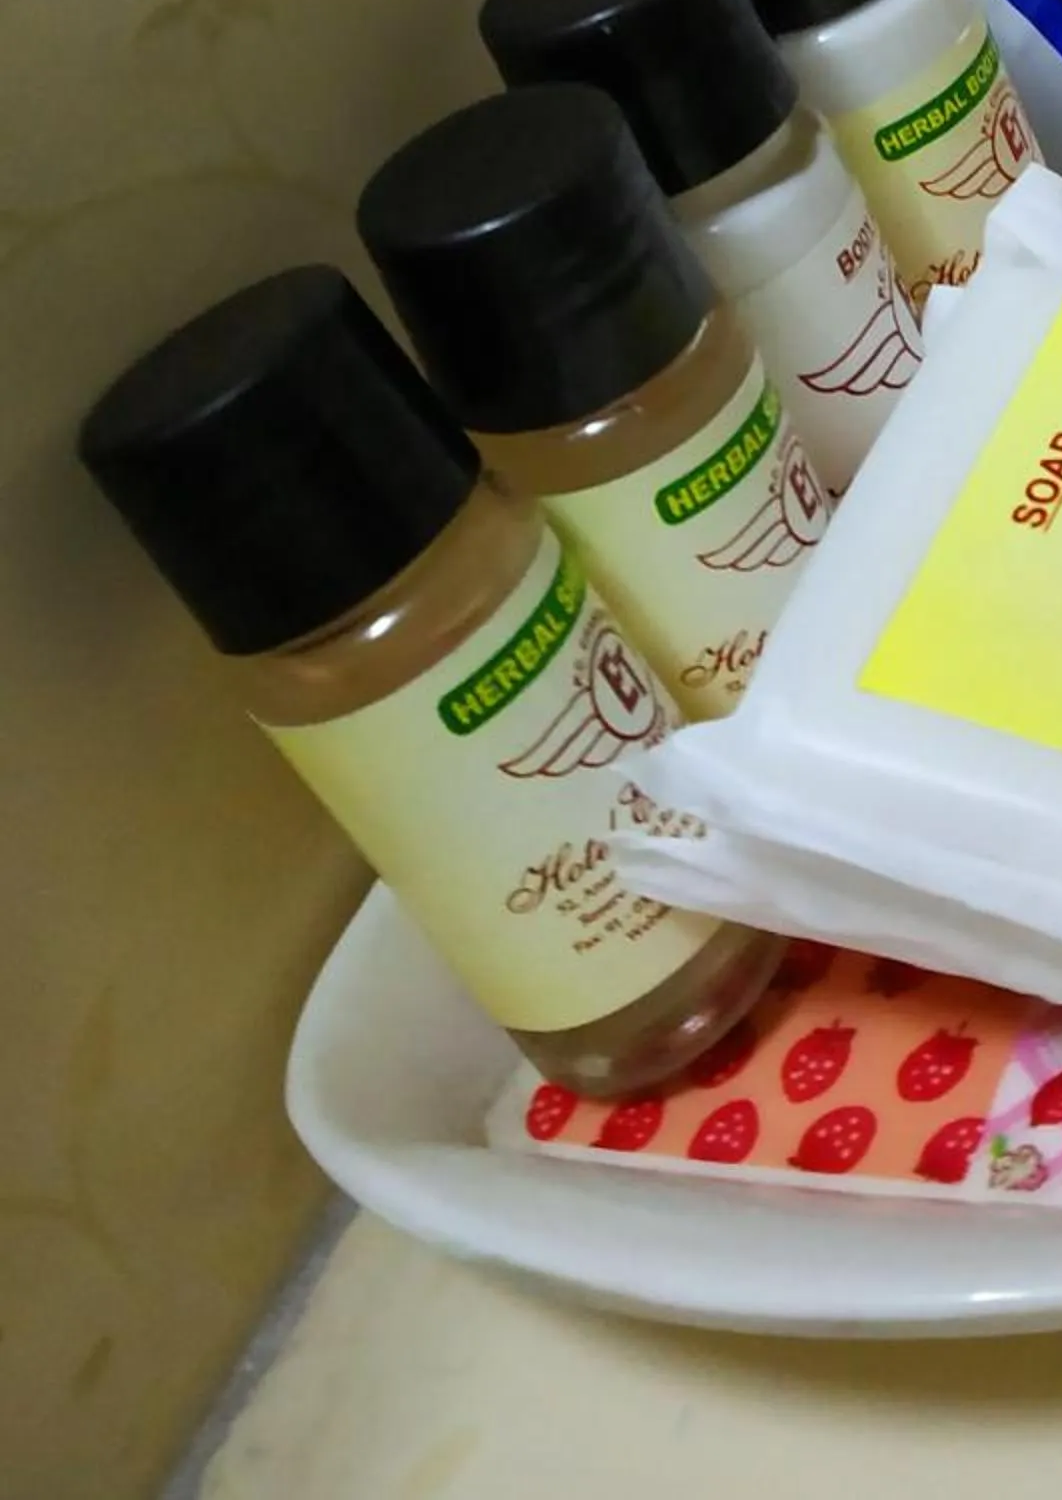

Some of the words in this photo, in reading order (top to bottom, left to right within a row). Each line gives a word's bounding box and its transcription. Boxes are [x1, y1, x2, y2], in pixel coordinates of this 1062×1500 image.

[881, 92, 968, 155] HERBAL
[910, 250, 981, 300] Hot
[666, 424, 769, 518] HERBAL
[451, 612, 566, 726] HERBAL
[600, 643, 649, 715] ET
[680, 629, 768, 689] Hot
